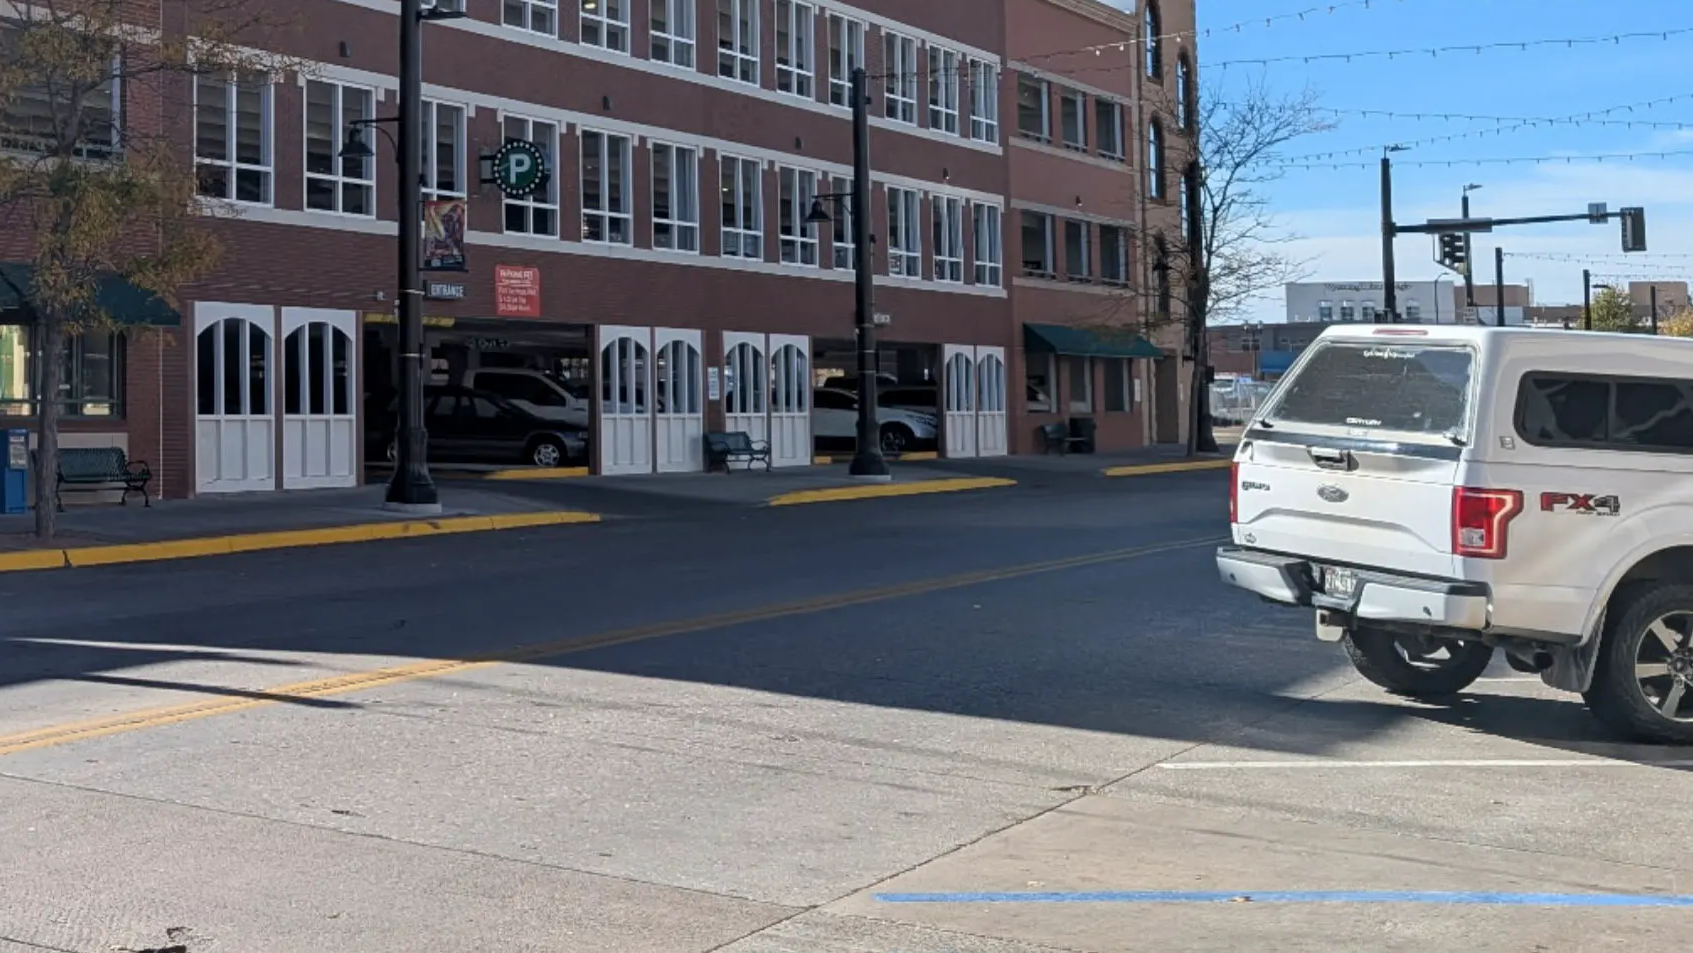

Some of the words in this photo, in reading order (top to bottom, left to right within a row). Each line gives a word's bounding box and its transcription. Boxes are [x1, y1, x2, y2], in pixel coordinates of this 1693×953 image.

[509, 153, 531, 184] P
[430, 283, 464, 297] ENTRANCE
[1540, 492, 1620, 513] FX4
